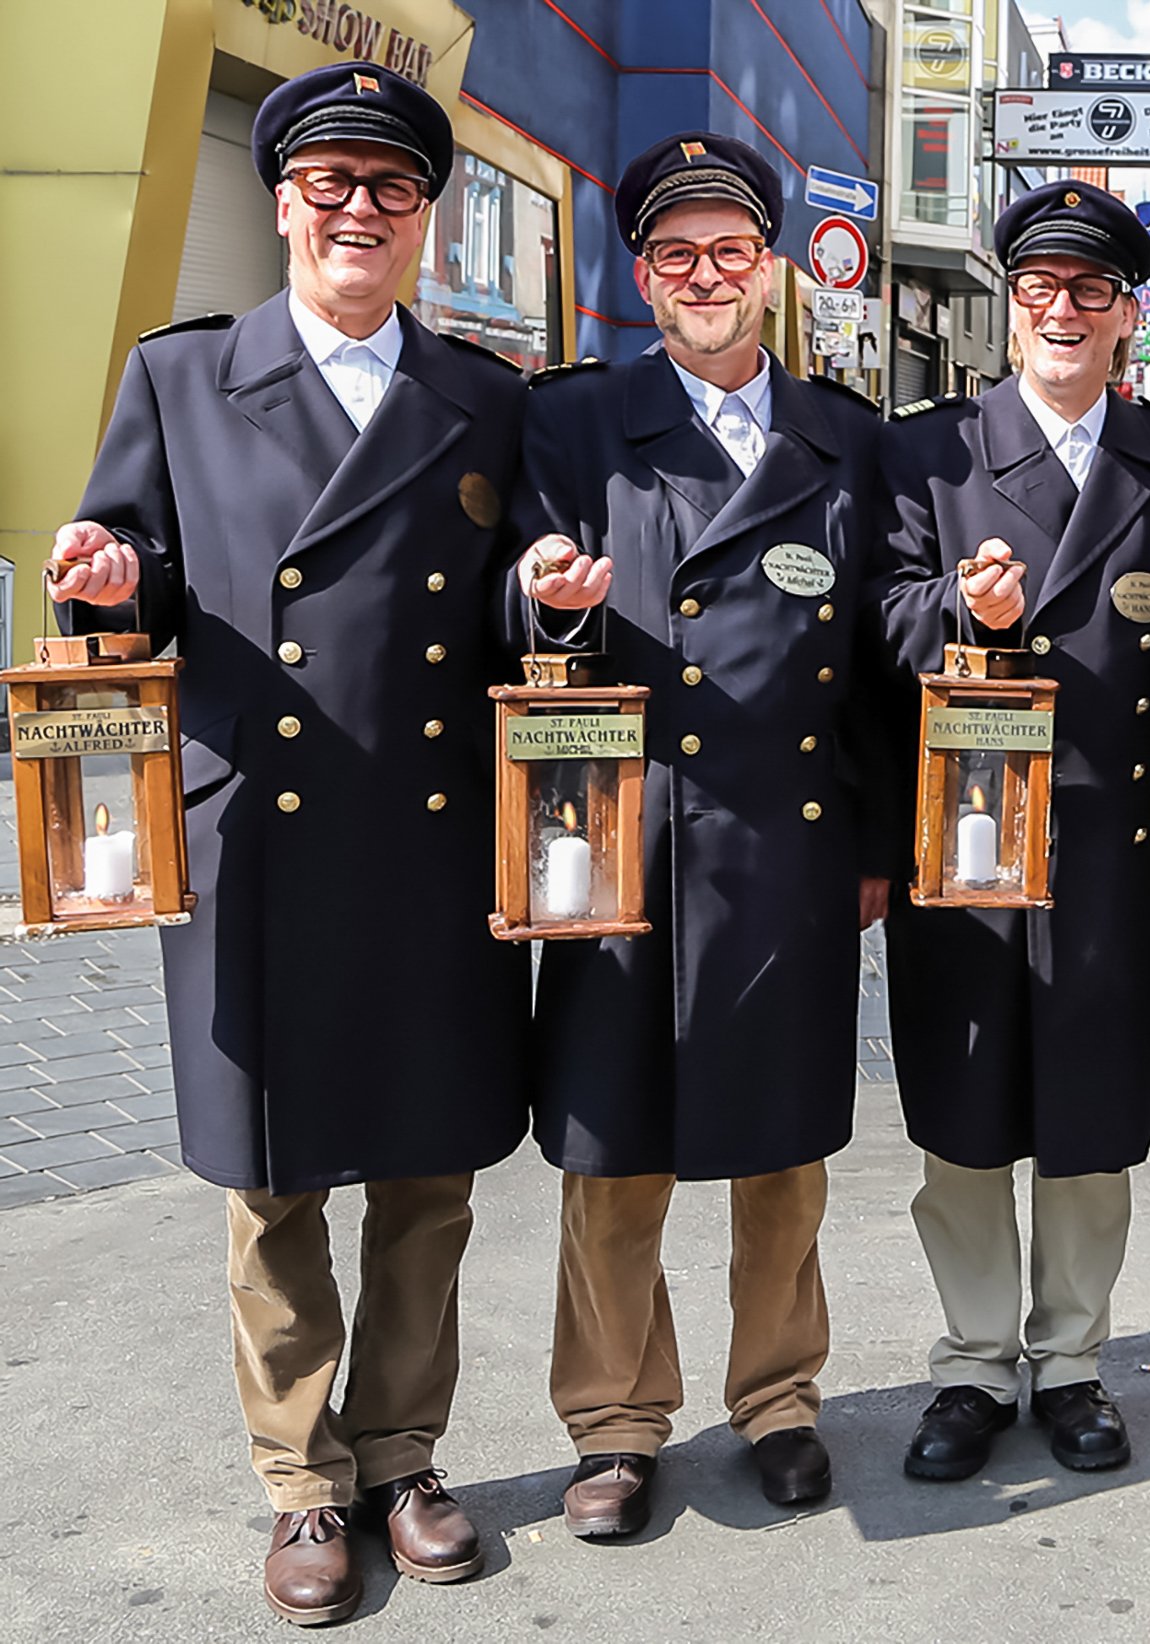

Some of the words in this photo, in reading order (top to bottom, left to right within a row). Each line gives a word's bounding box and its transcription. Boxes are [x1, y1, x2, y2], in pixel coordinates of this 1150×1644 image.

[298, 0, 387, 60] SHOW
[1024, 114, 1048, 122] Hier
[1028, 124, 1047, 133] die
[1050, 119, 1082, 130] Party
[18, 719, 165, 740] NACHTWÄCHTER
[551, 718, 564, 727] ST.
[569, 718, 600, 727] PAULI
[63, 738, 123, 752] ALFRED
[976, 738, 1004, 746] HANS
